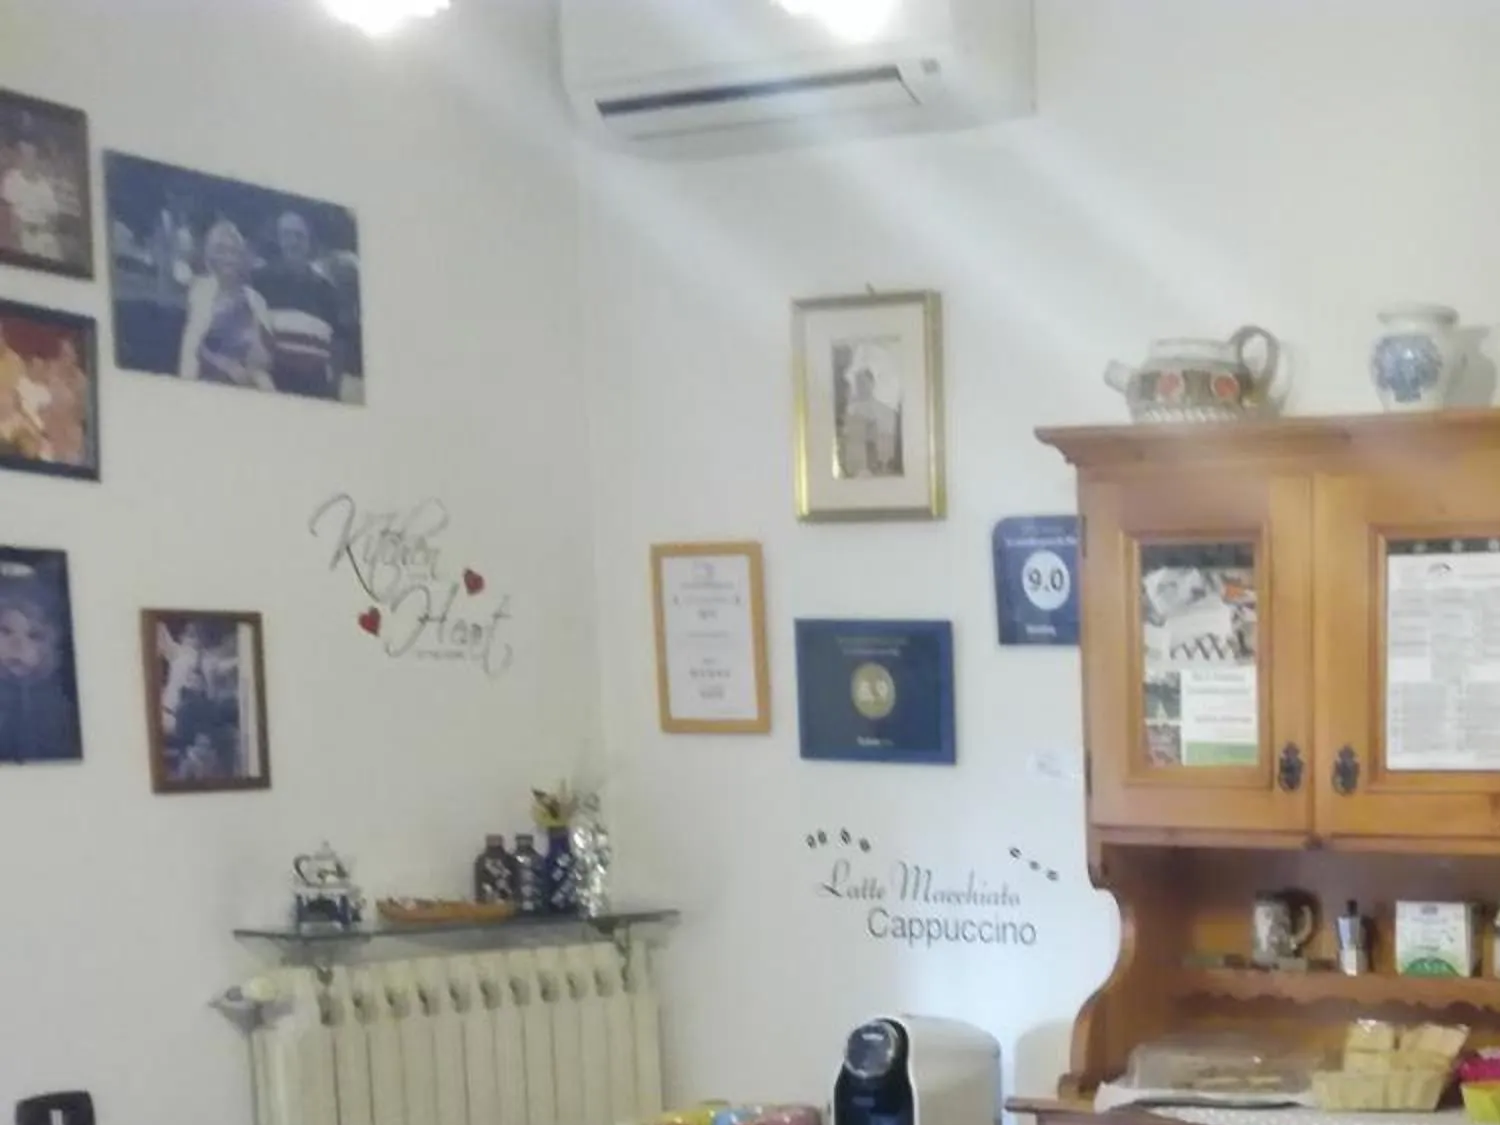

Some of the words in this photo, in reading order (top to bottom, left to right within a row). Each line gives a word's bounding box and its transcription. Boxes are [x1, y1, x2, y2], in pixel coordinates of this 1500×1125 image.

[1029, 567, 1065, 592] 9.0
[819, 859, 886, 899] Latte
[895, 860, 1021, 905] Macchiato
[867, 907, 1037, 947] Cappuccino
